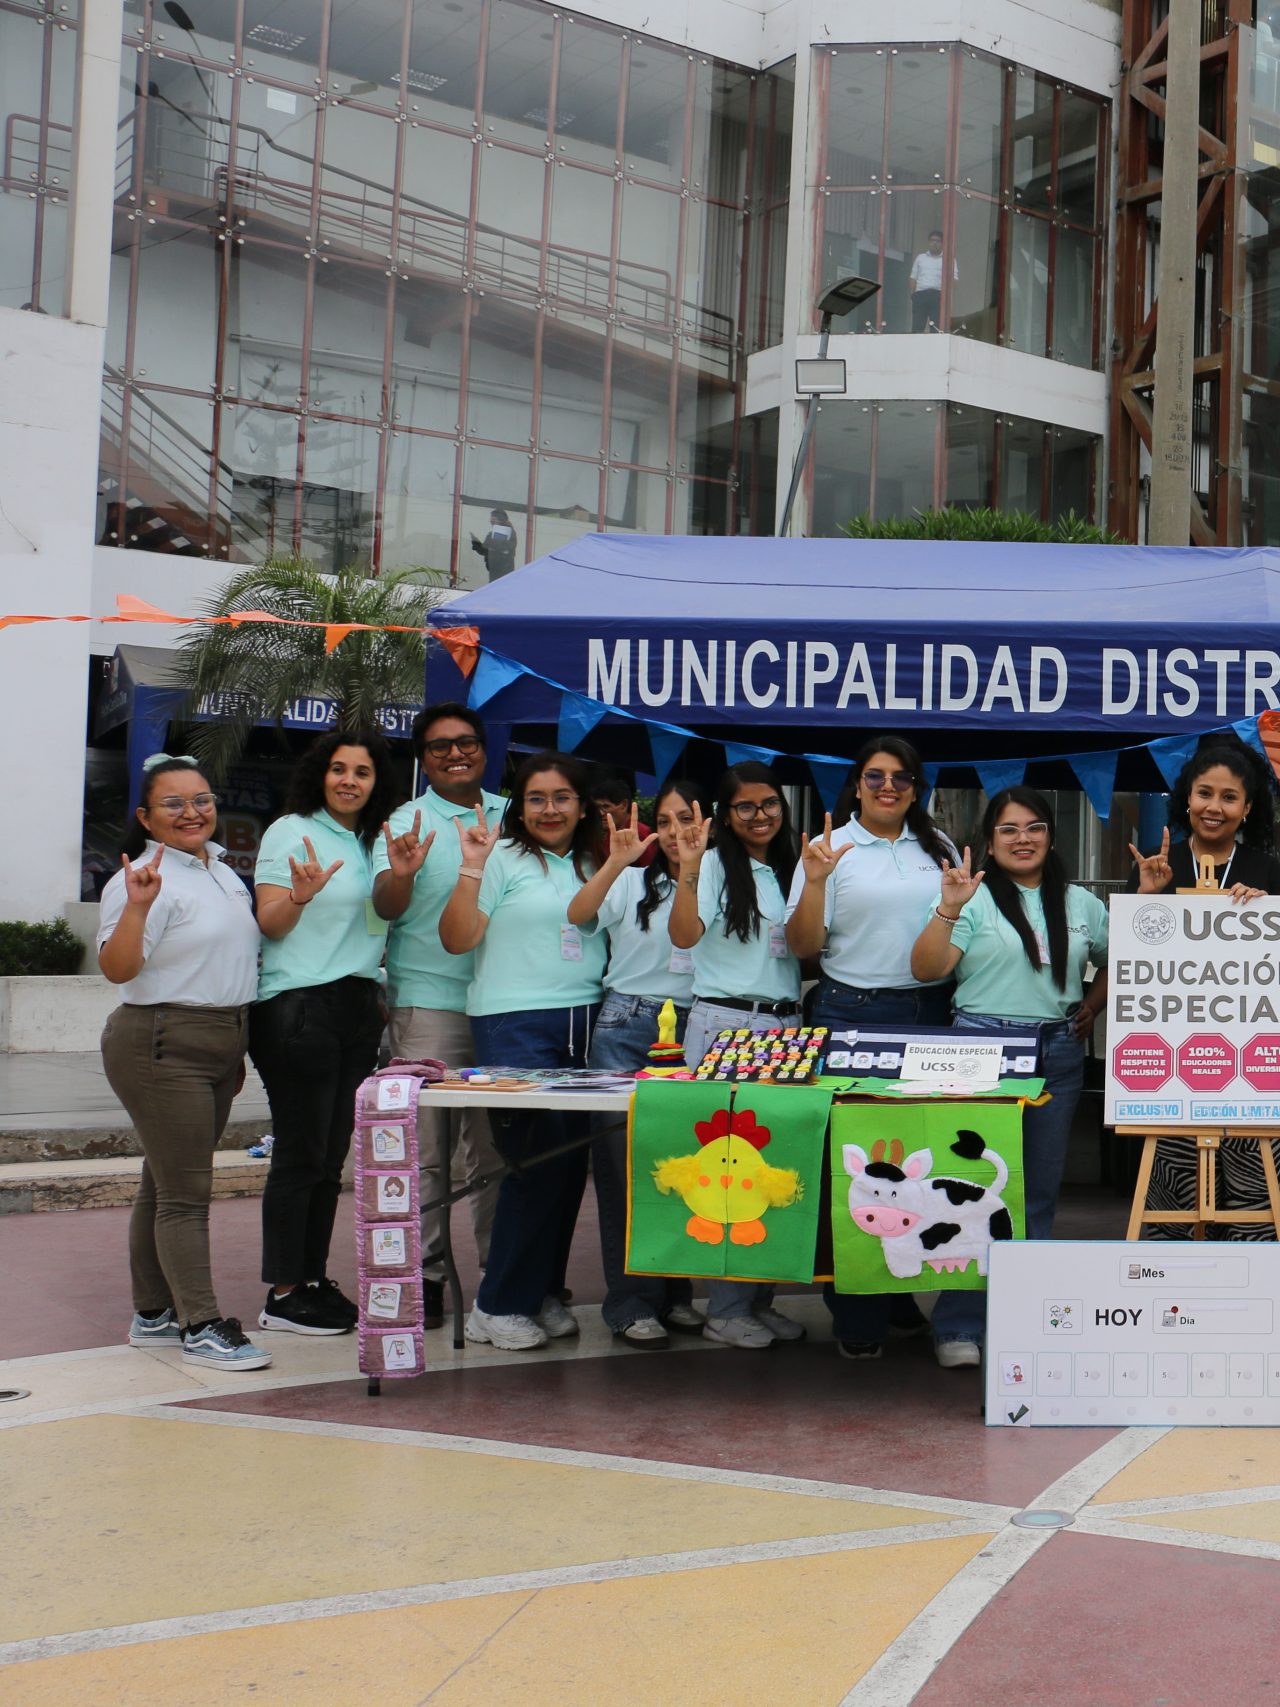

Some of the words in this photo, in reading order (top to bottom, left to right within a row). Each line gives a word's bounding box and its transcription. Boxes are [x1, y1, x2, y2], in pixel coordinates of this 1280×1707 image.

[587, 638, 1068, 713] MUNICIPALIDAD
[909, 1046, 957, 1055] EDUCACIÓN
[959, 1047, 998, 1056] ESPECIAL
[1122, 1048, 1164, 1056] CONTIENE
[1188, 1047, 1226, 1057] 100%
[921, 1062, 955, 1072] UCSS
[1120, 1067, 1166, 1076] INCLUSIÓN
[1119, 1104, 1180, 1116] EXCLUSIVO
[1194, 1103, 1238, 1117] EDICIÓN
[1141, 1267, 1165, 1279] Mes
[1094, 1308, 1143, 1327] HOY
